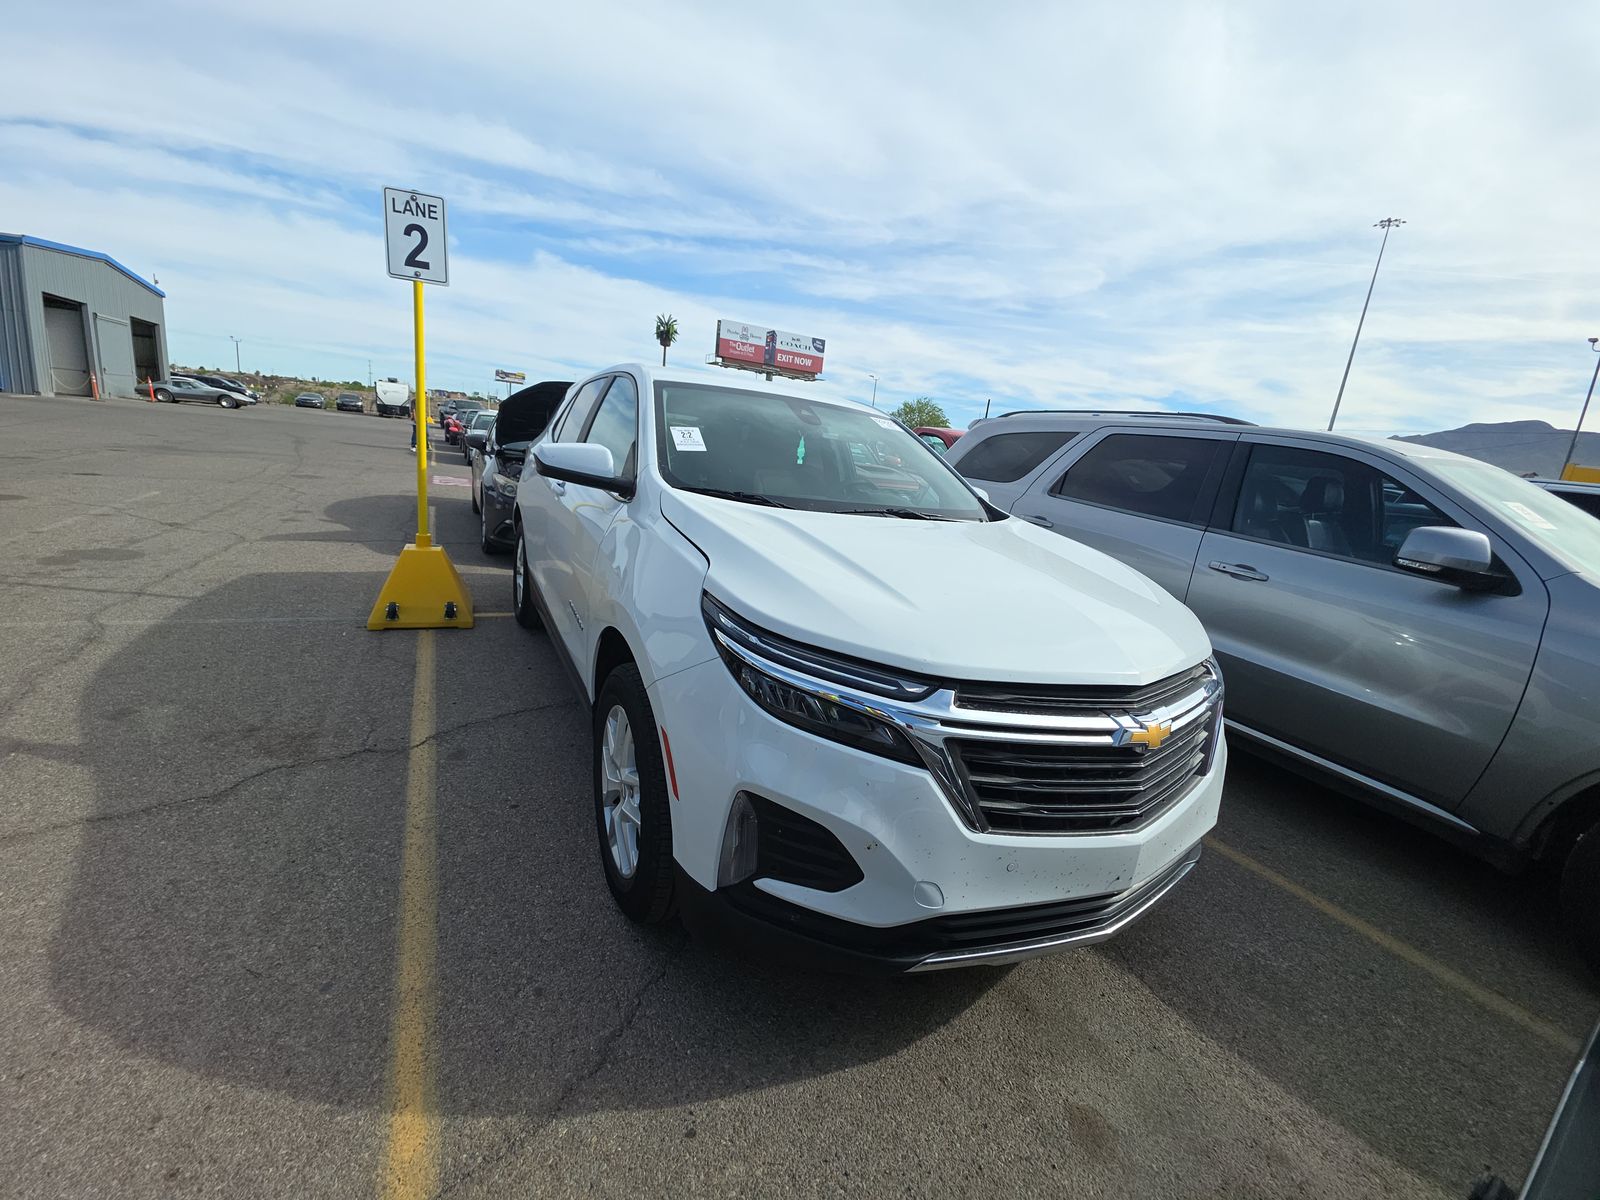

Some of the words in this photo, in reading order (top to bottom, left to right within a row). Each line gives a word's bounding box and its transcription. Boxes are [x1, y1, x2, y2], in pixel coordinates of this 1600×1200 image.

[392, 197, 438, 220] LANE
[403, 223, 430, 270] 2
[736, 341, 755, 353] Outlet
[777, 353, 794, 363] EXIT
[795, 356, 813, 366] NOW
